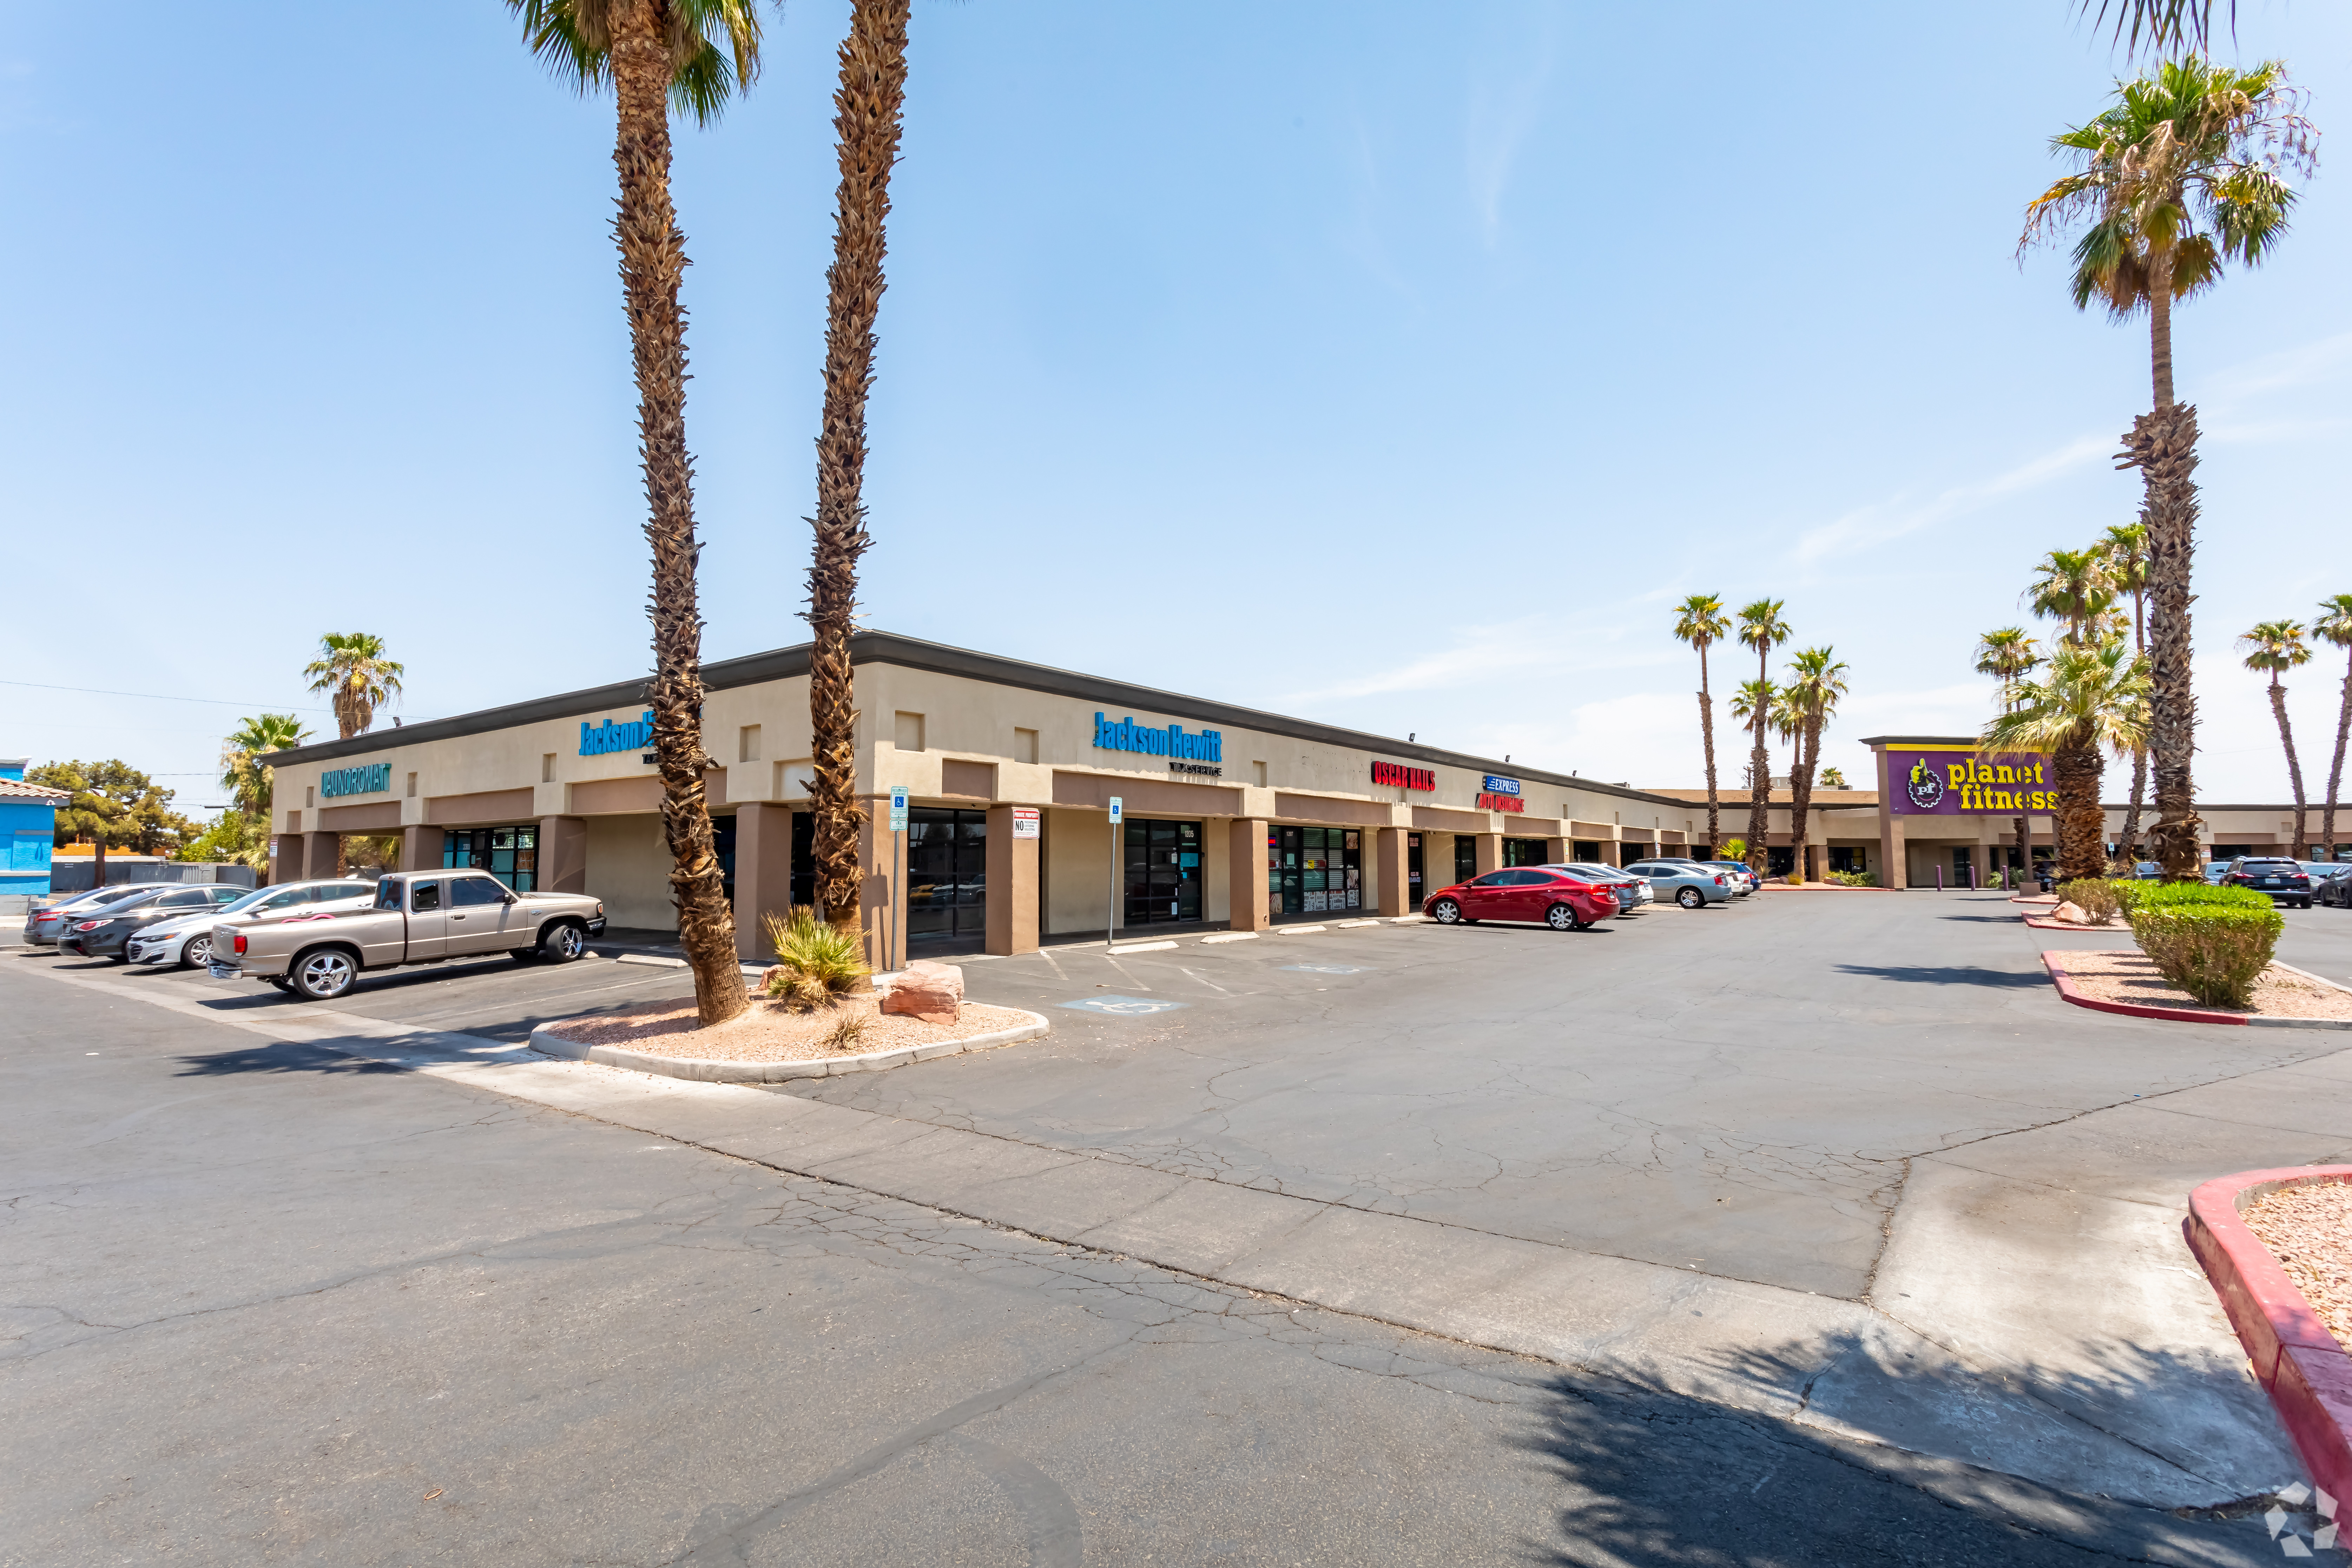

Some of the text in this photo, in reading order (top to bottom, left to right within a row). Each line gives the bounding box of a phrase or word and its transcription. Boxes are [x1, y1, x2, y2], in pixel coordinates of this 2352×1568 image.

[579, 719, 643, 755] Jackson
[1093, 712, 1222, 762] Jackson Hewitt
[321, 763, 391, 797] LAUNDROMAT
[1169, 762, 1222, 777] TAX SERVICE
[1371, 761, 1435, 792] OSCAR NAILS
[1945, 758, 2044, 790] planet
[1495, 778, 1518, 793] EXPRESS
[1917, 783, 1936, 795] pf
[1958, 783, 2059, 810] fitness
[1476, 793, 1525, 813] AUTO INSURANCE
[1015, 821, 1023, 831] NO
